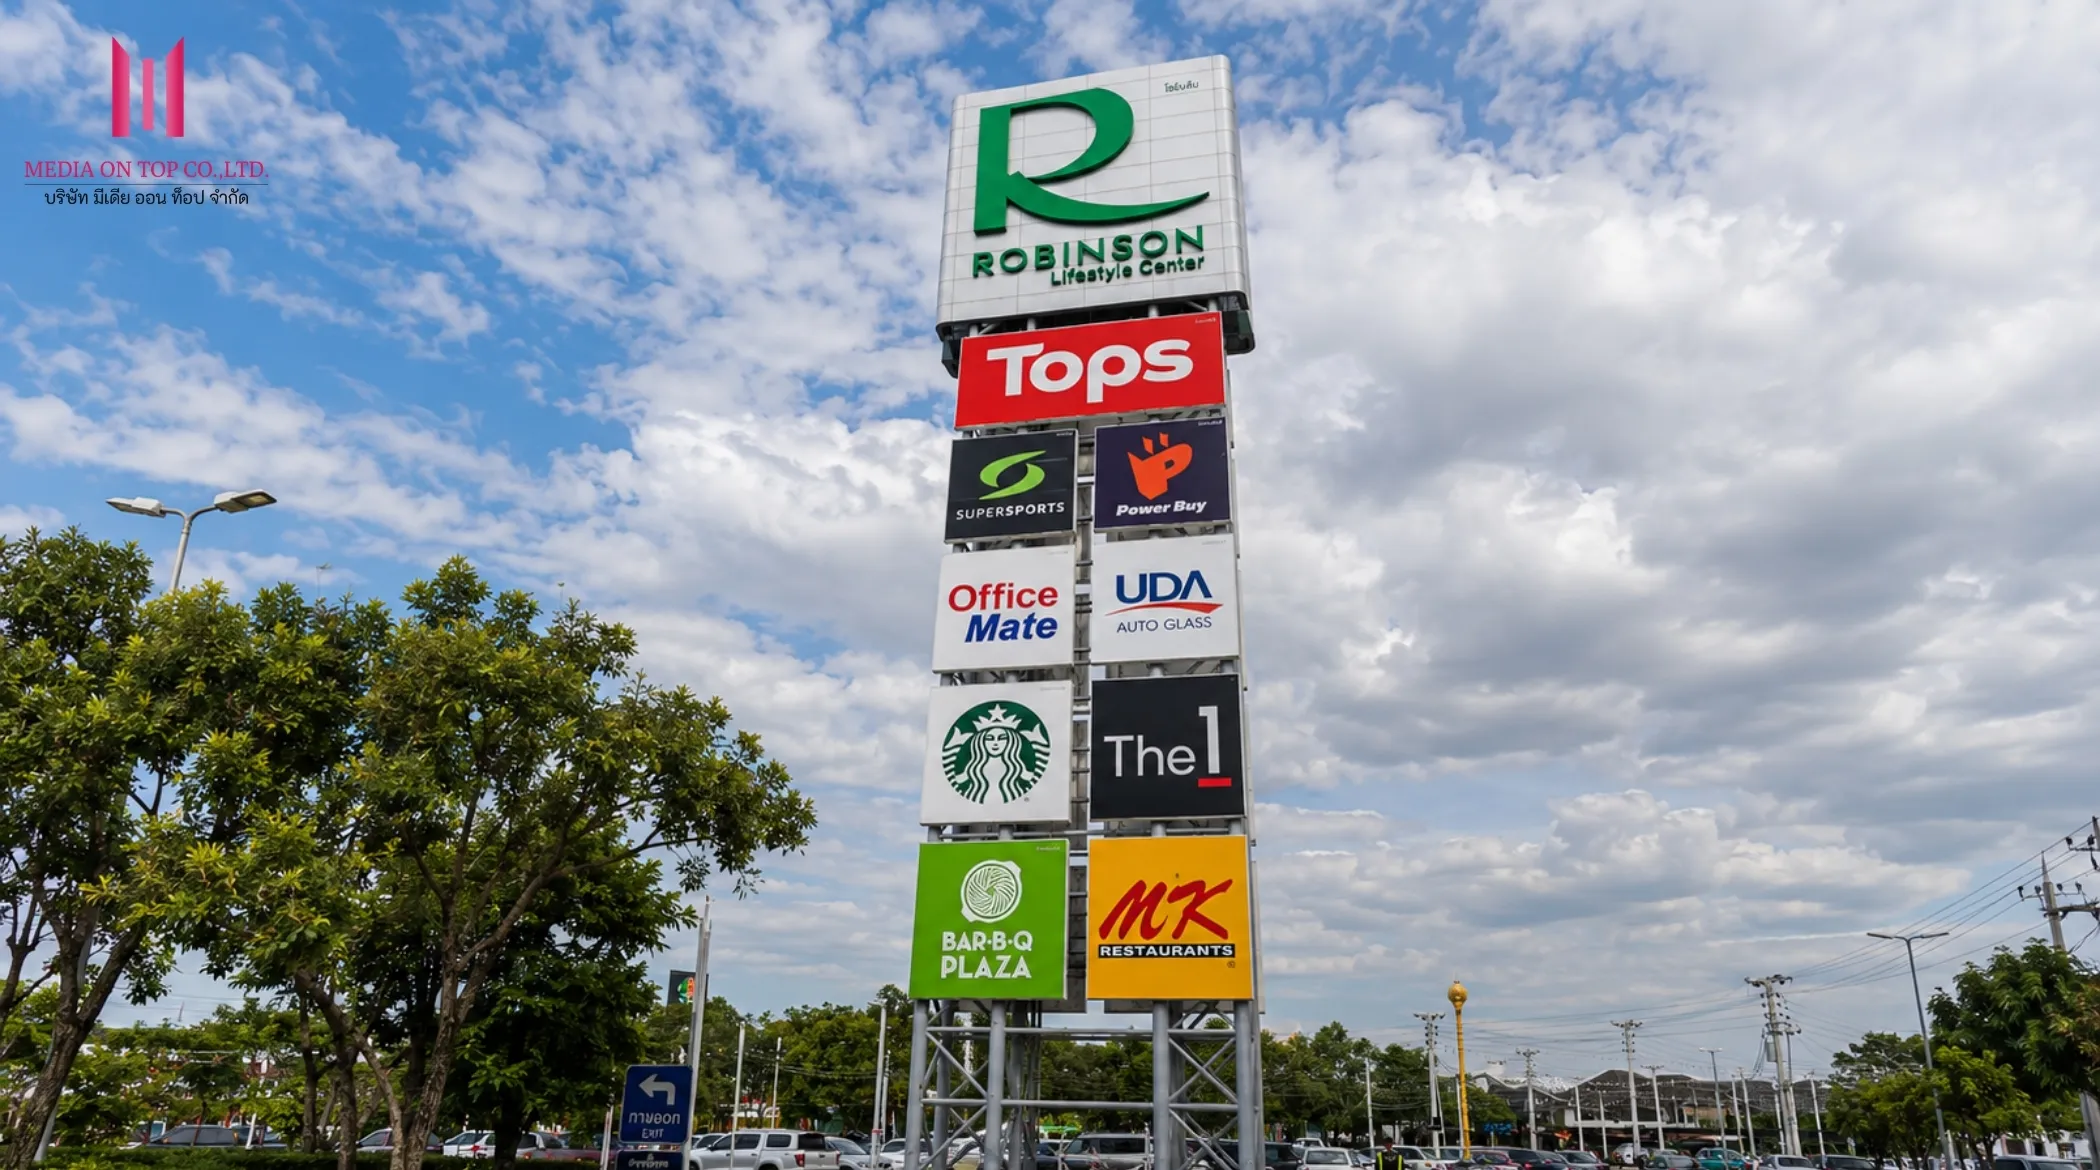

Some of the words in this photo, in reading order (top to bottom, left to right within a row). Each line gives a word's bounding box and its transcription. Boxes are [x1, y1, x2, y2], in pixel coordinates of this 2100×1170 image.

[974, 87, 1210, 236] R
[972, 225, 1204, 278] ROBINSON
[1051, 264, 1133, 287] Lifestyle
[1139, 256, 1204, 276] Center
[986, 339, 1194, 403] Tops
[956, 502, 1065, 520] SUPERSPORTS
[1115, 501, 1171, 517] Power
[1173, 499, 1207, 514] Buy
[948, 582, 1058, 612] Office
[1115, 570, 1213, 604] UDA
[964, 612, 1058, 643] Mate
[1116, 619, 1159, 634] AUTO
[1163, 616, 1213, 631] GLASS
[1103, 734, 1196, 777] The
[1098, 879, 1233, 940] MK
[1100, 945, 1233, 957] RESTAURANTS
[940, 955, 1032, 979] PLAZA
